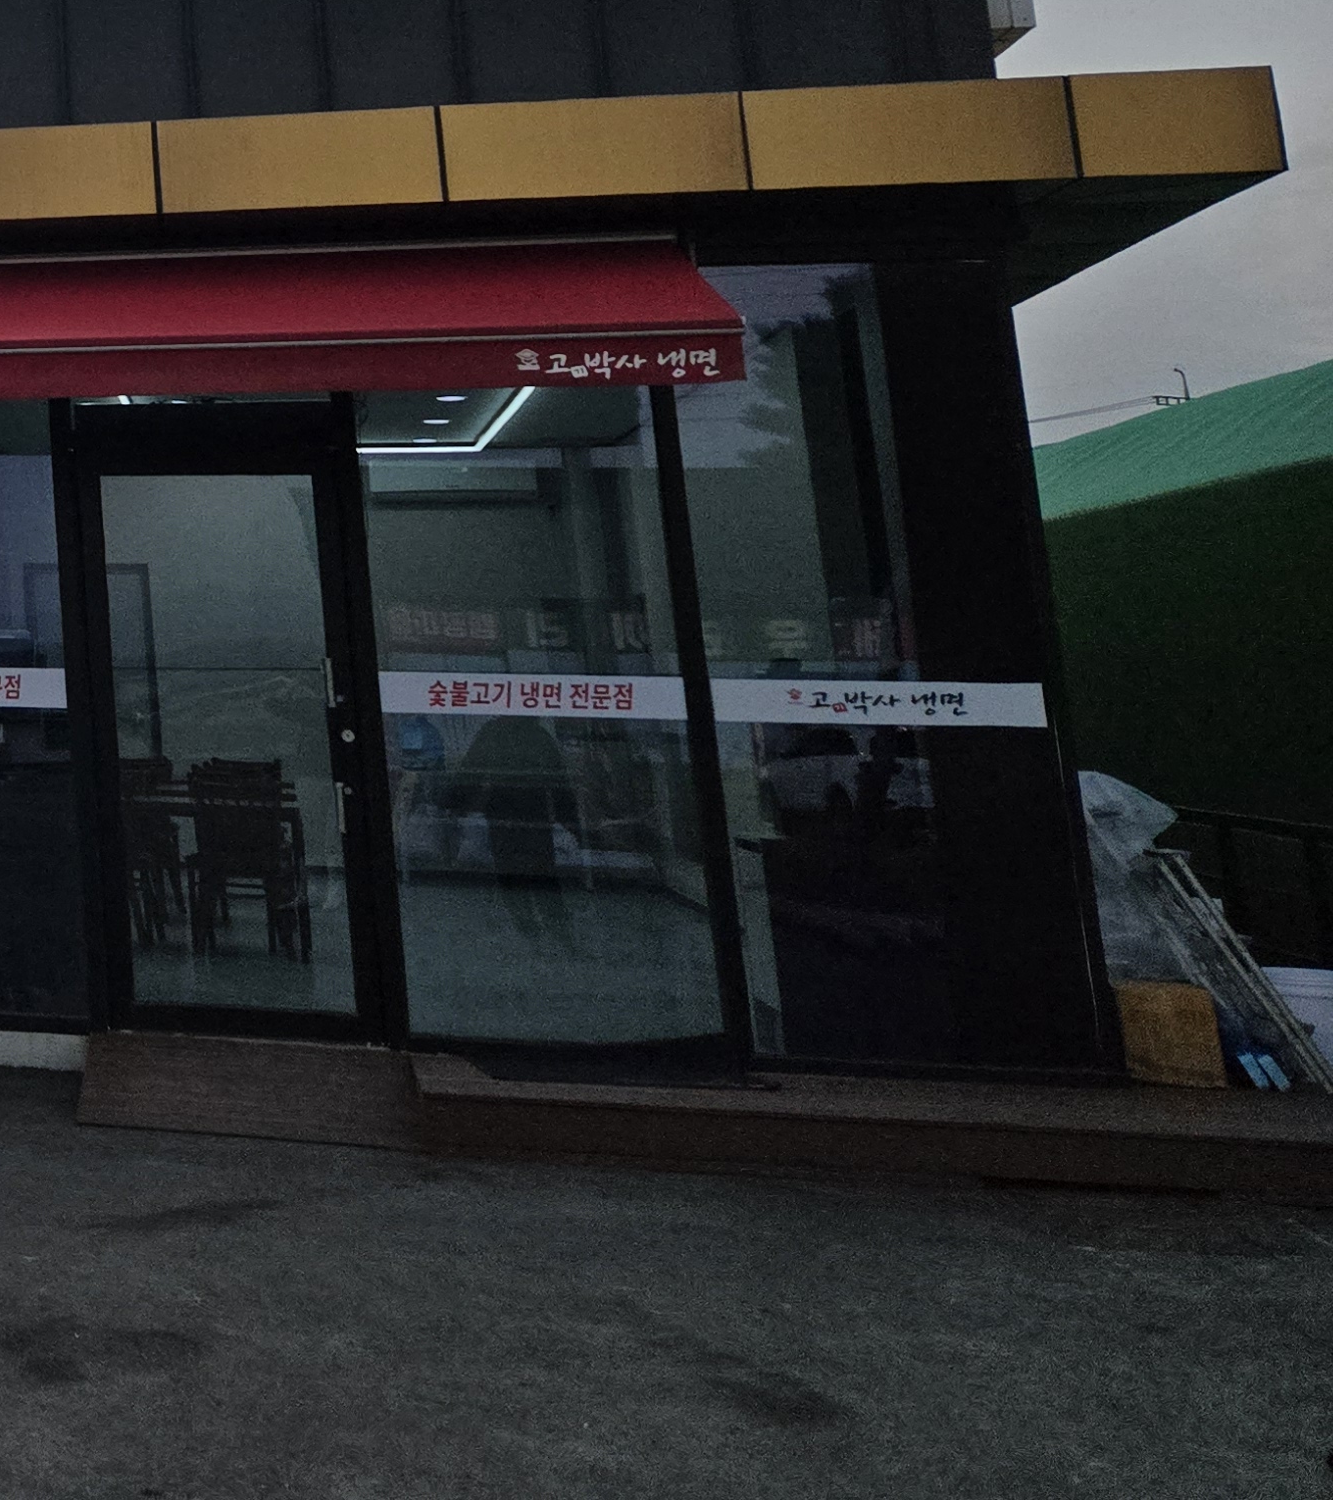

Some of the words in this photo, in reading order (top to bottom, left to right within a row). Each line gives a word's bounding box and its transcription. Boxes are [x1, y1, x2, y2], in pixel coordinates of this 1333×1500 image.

[657, 348, 721, 379] 냉면
[427, 680, 513, 708] 숯불고기
[519, 681, 562, 710] 냉면
[568, 682, 634, 712] 전문점
[910, 689, 966, 717] 냉면
